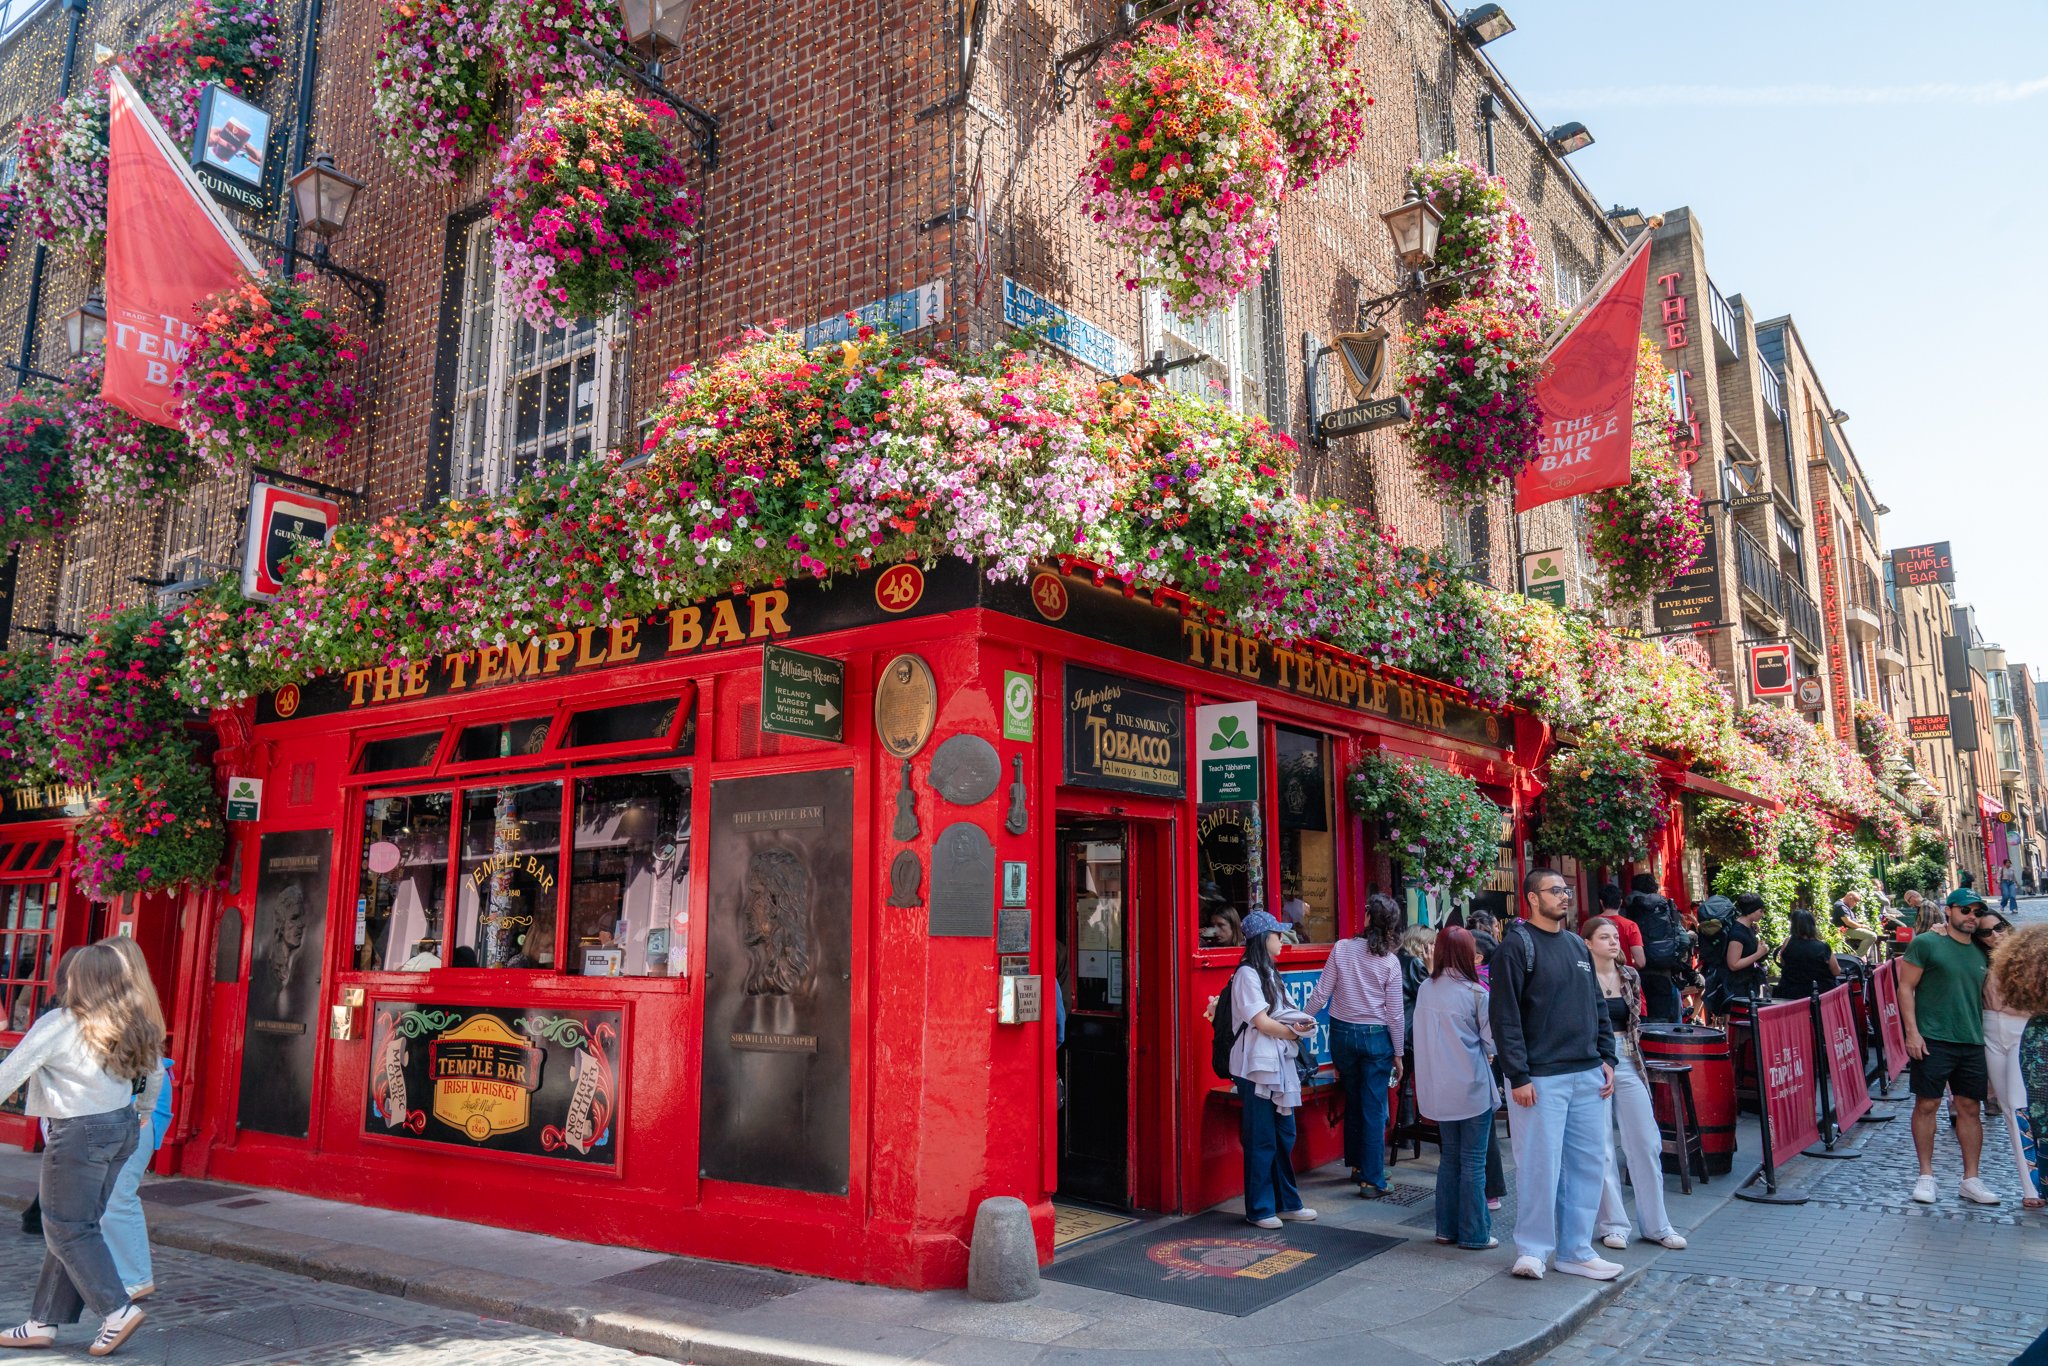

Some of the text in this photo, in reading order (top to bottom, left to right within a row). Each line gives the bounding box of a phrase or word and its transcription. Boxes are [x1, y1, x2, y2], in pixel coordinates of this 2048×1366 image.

[195, 170, 264, 209] GUINNESS
[926, 294, 939, 314] 2
[1658, 272, 1688, 350] THE
[1325, 402, 1397, 430] GUINNESS
[1552, 415, 1593, 435] THE
[1537, 416, 1618, 455] EMPLE
[1541, 446, 1592, 472] BAR
[1730, 494, 1769, 506] GUINNESS
[1907, 546, 1936, 560] THE
[1897, 556, 1950, 573] TEMPLE
[882, 573, 914, 603] 48
[1909, 571, 1938, 584] BAR
[1038, 578, 1063, 611] 48
[1659, 596, 1714, 609] LIVE MUSIC
[1672, 606, 1702, 617] DAILY
[1815, 500, 1849, 737] THE WHISKEY RESERVE
[347, 590, 791, 705] THE TEMPLE BAR
[769, 658, 840, 686] The Whiskey Reserve
[1182, 619, 1445, 729] THE TEMPLE BAR
[280, 690, 295, 712] 48
[775, 686, 811, 699] IRELAND'S
[777, 696, 808, 707] LARGEST
[1068, 685, 1121, 715] Importers
[770, 712, 814, 726] COLLECTION
[777, 704, 808, 716] WHISKEY
[1102, 703, 1112, 713] OF
[1116, 713, 1170, 734] FINE SMOKING
[1923, 716, 1948, 724] TEMPLE
[1085, 715, 1171, 767] TOBACCO
[1103, 761, 1177, 783] Always in Stock
[13, 782, 98, 811] THE TEMPL
[756, 810, 796, 822] TEMPLE
[800, 807, 820, 819] BAR
[502, 828, 521, 841] THE
[1197, 807, 1240, 845] TEMPLE
[465, 851, 554, 894] TEMPLE BAR
[1019, 1006, 1037, 1014] DUBLIN
[731, 1034, 815, 1046] SIR WILLIAM TEMPLE
[471, 1044, 495, 1059] THE
[393, 1049, 405, 1111] MALBEC
[438, 1058, 527, 1082] TEMPLE BAR
[388, 1064, 398, 1101] CASK
[443, 1080, 518, 1102] IRISH WHISKEY
[567, 1070, 588, 1135] EDITION
[574, 1066, 597, 1141] LIMITED
[472, 1124, 486, 1133] 1840
